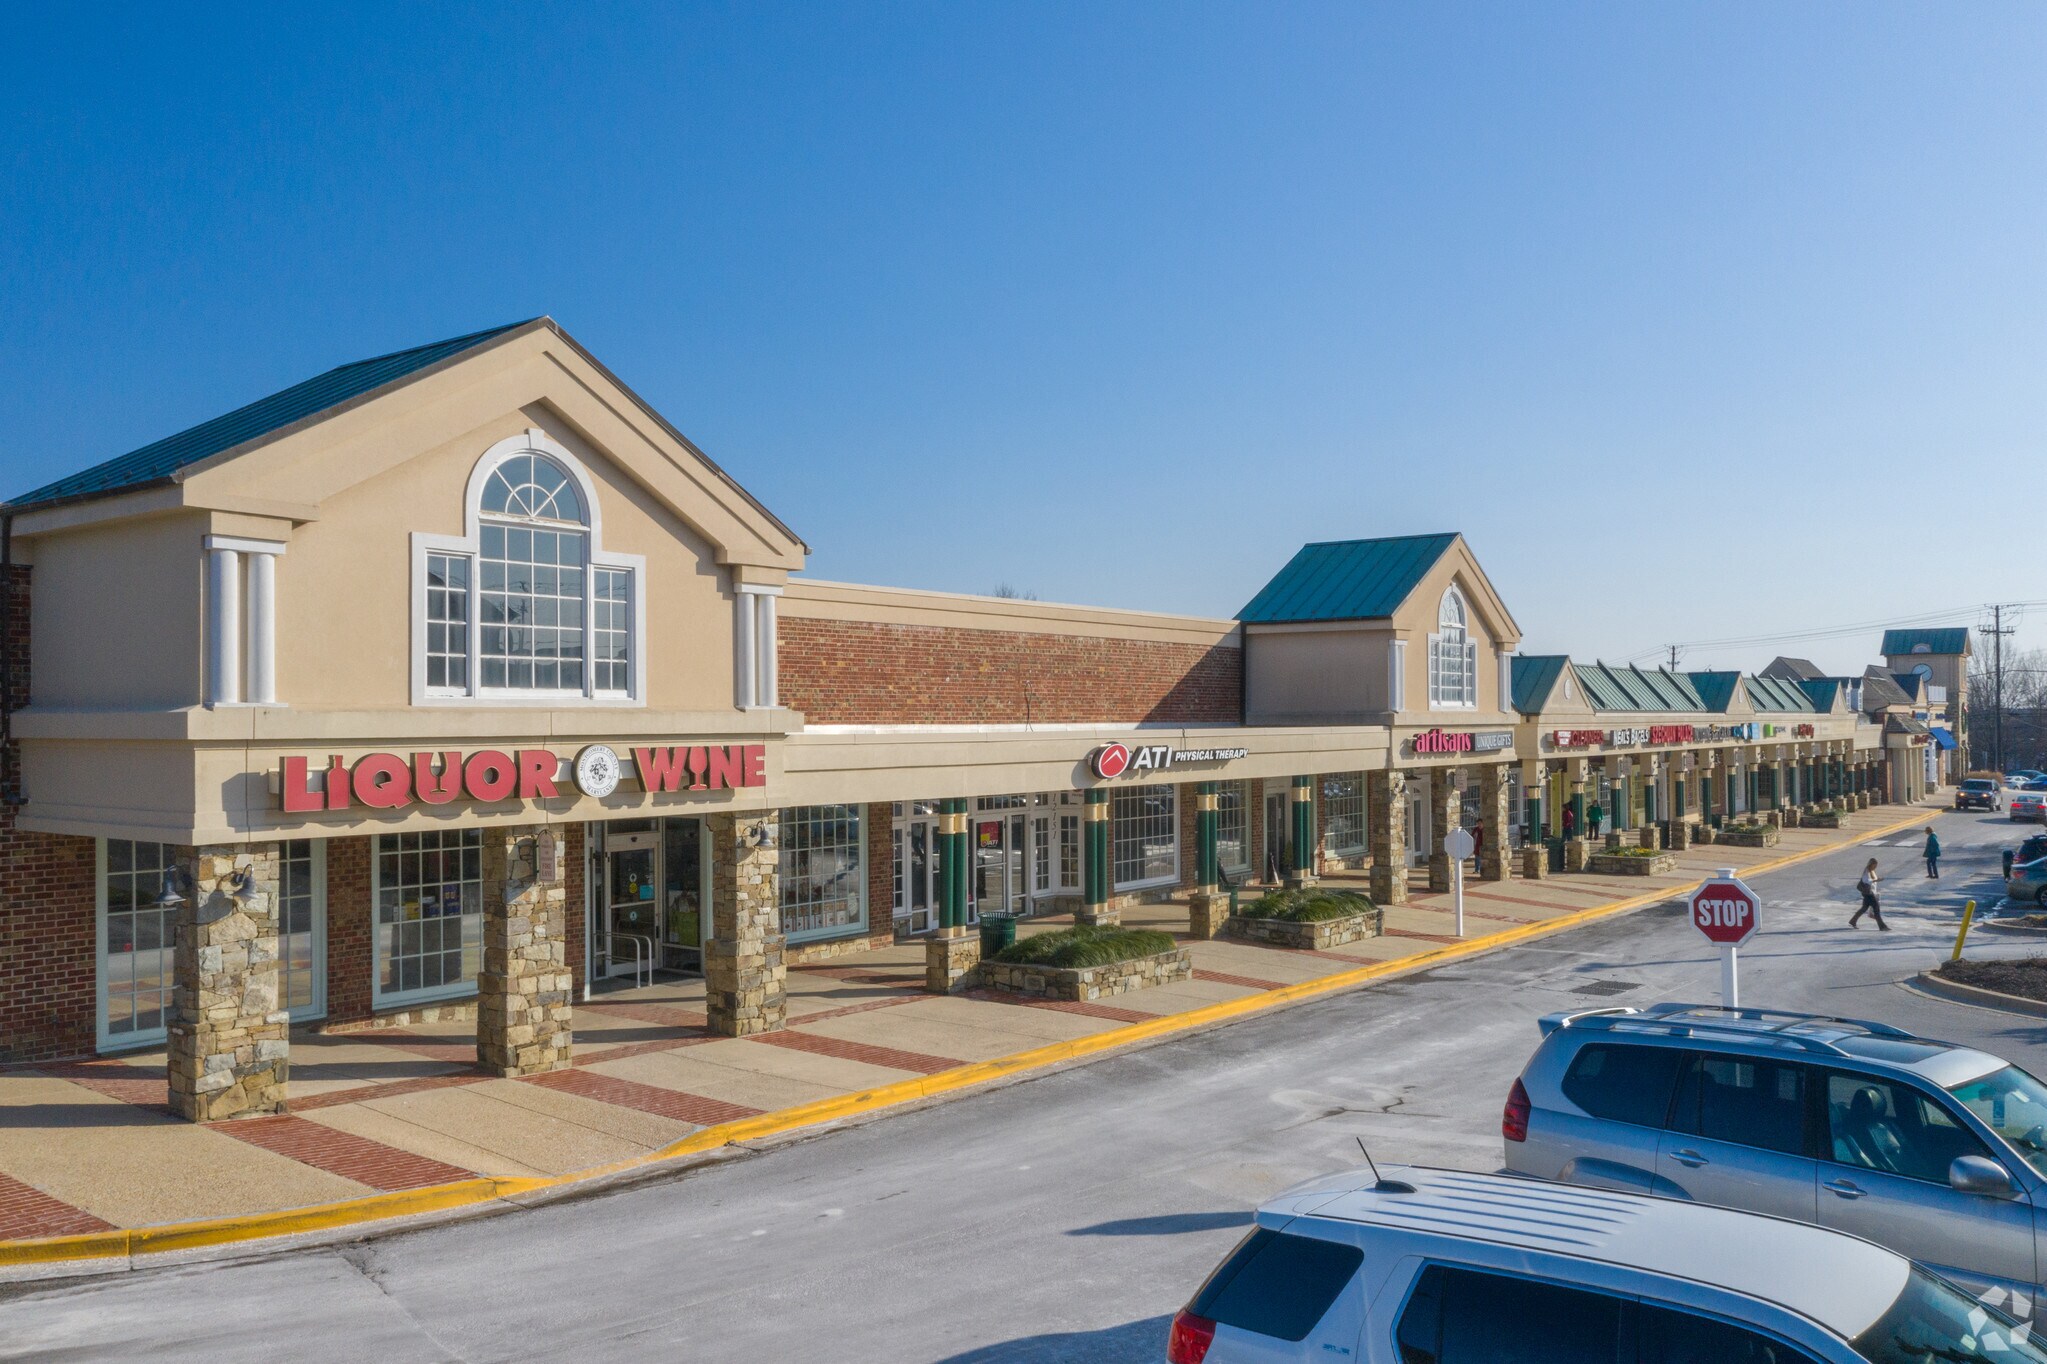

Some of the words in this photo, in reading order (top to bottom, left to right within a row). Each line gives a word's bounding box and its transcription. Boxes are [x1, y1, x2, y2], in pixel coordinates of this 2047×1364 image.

[1415, 728, 1472, 752] artisans
[1476, 735, 1497, 749] UNIQUE
[1497, 734, 1512, 746] GIFTS
[606, 749, 619, 770] COUNTY
[1133, 746, 1173, 769] ATI
[1174, 749, 1214, 762] PHYSICAL
[1214, 747, 1249, 761] THERAPY
[280, 749, 560, 813] LIQUOR
[631, 744, 766, 793] WINE
[586, 784, 613, 795] MARYLAND
[1698, 898, 1749, 927] STOP
